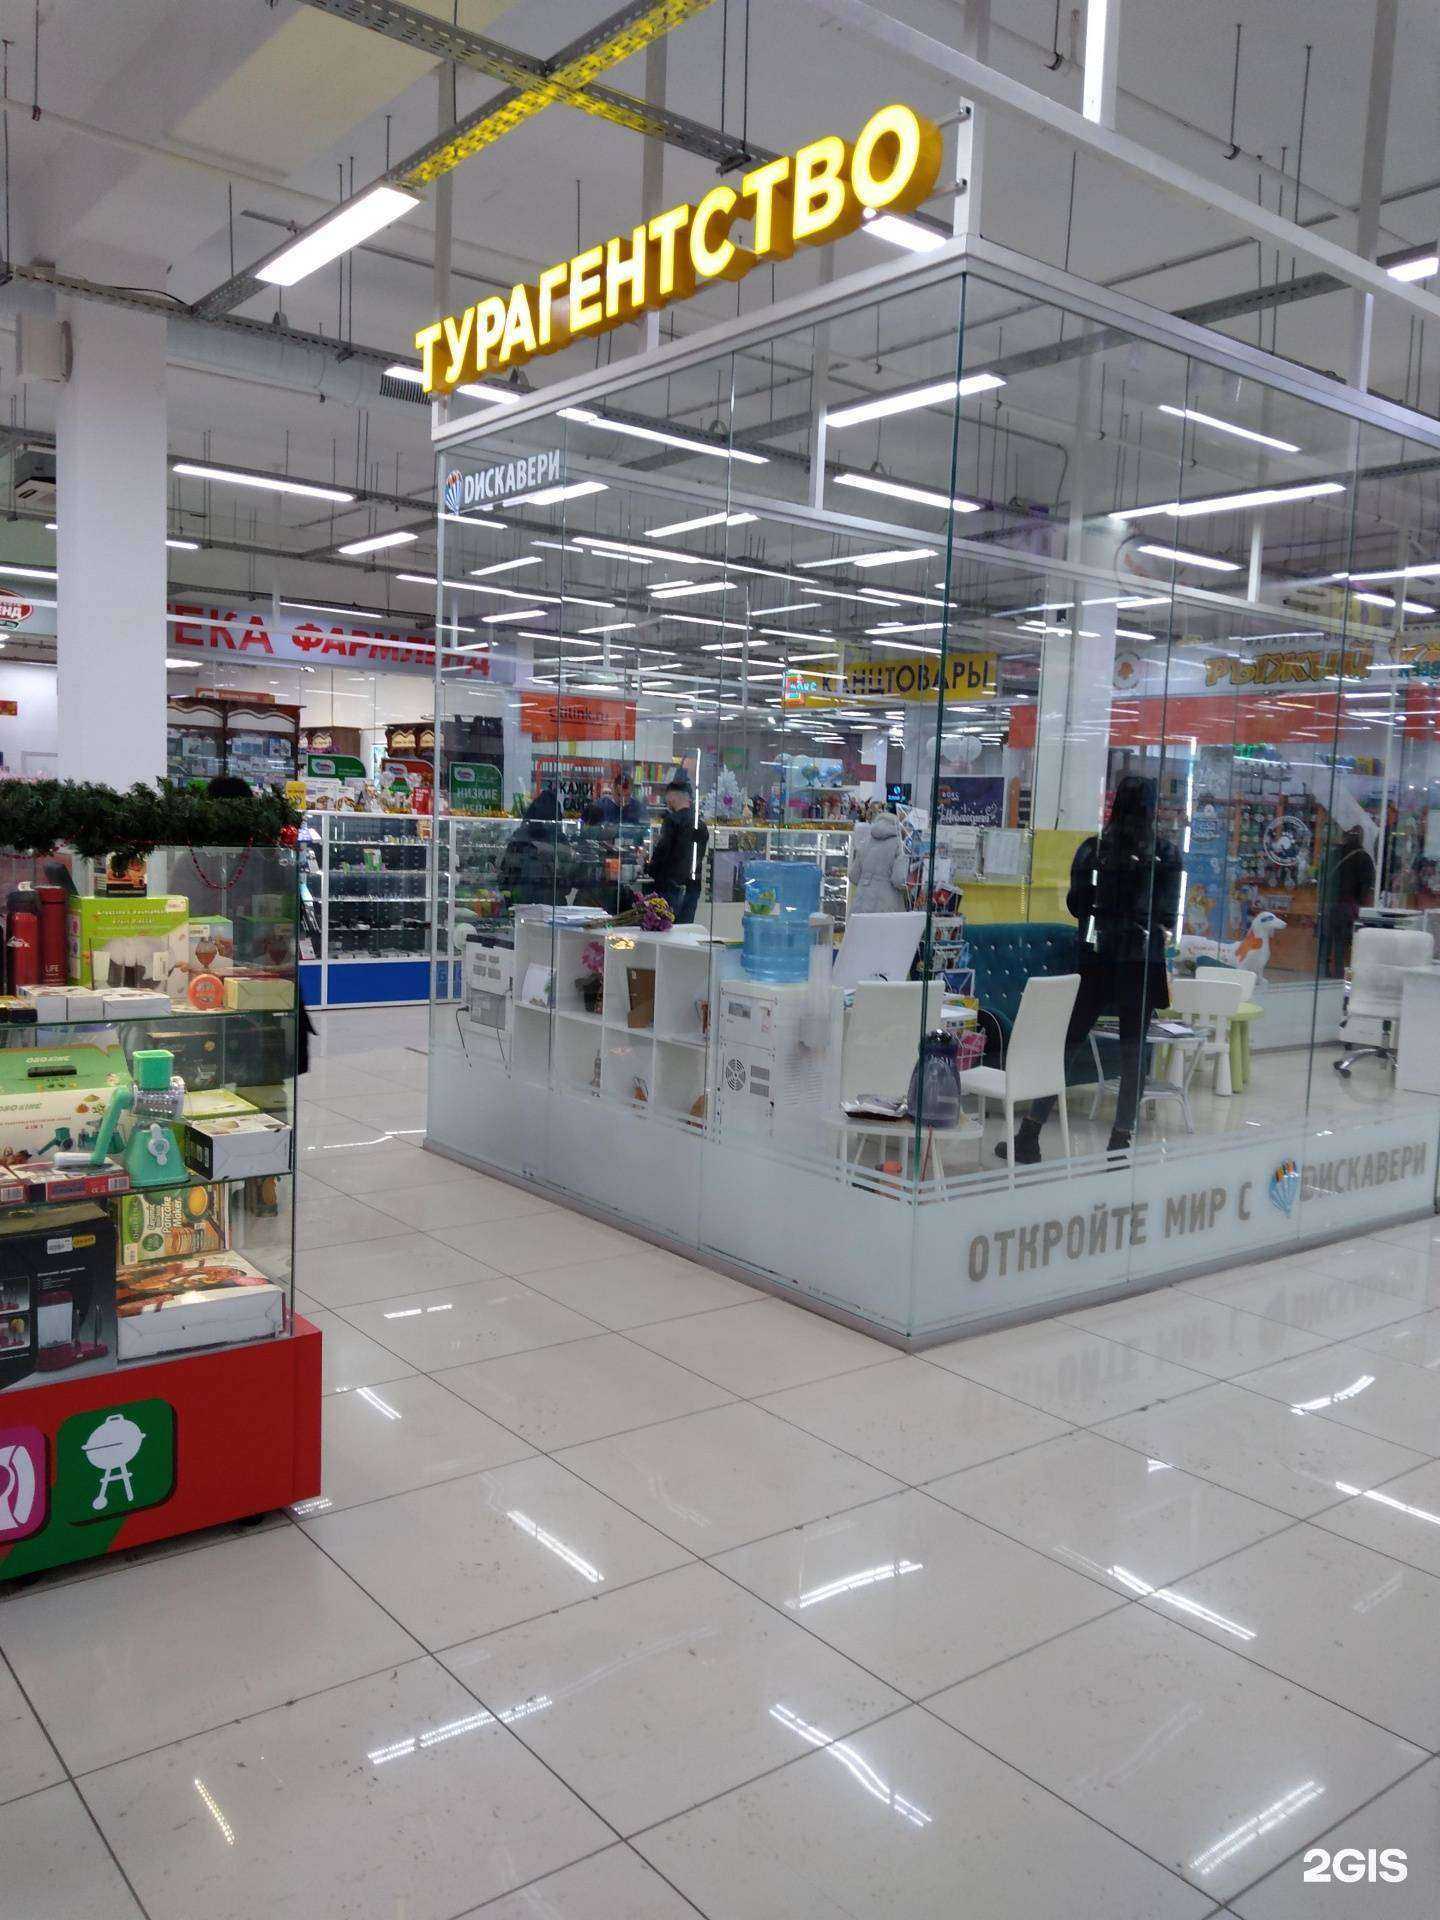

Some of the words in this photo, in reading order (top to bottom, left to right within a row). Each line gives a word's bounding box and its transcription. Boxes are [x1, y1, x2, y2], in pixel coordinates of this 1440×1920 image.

[414, 104, 930, 394] ТУРАГЕНТСТВО
[168, 603, 274, 654] ЕКА
[456, 787, 498, 800] НИЗКИЕ
[161, 1195, 172, 1233] Pancake
[172, 1198, 183, 1228] Maker
[968, 1202, 1148, 1283] ОТКРОЙТЕ
[1164, 1186, 1227, 1239] МИР
[1237, 1181, 1254, 1221] С
